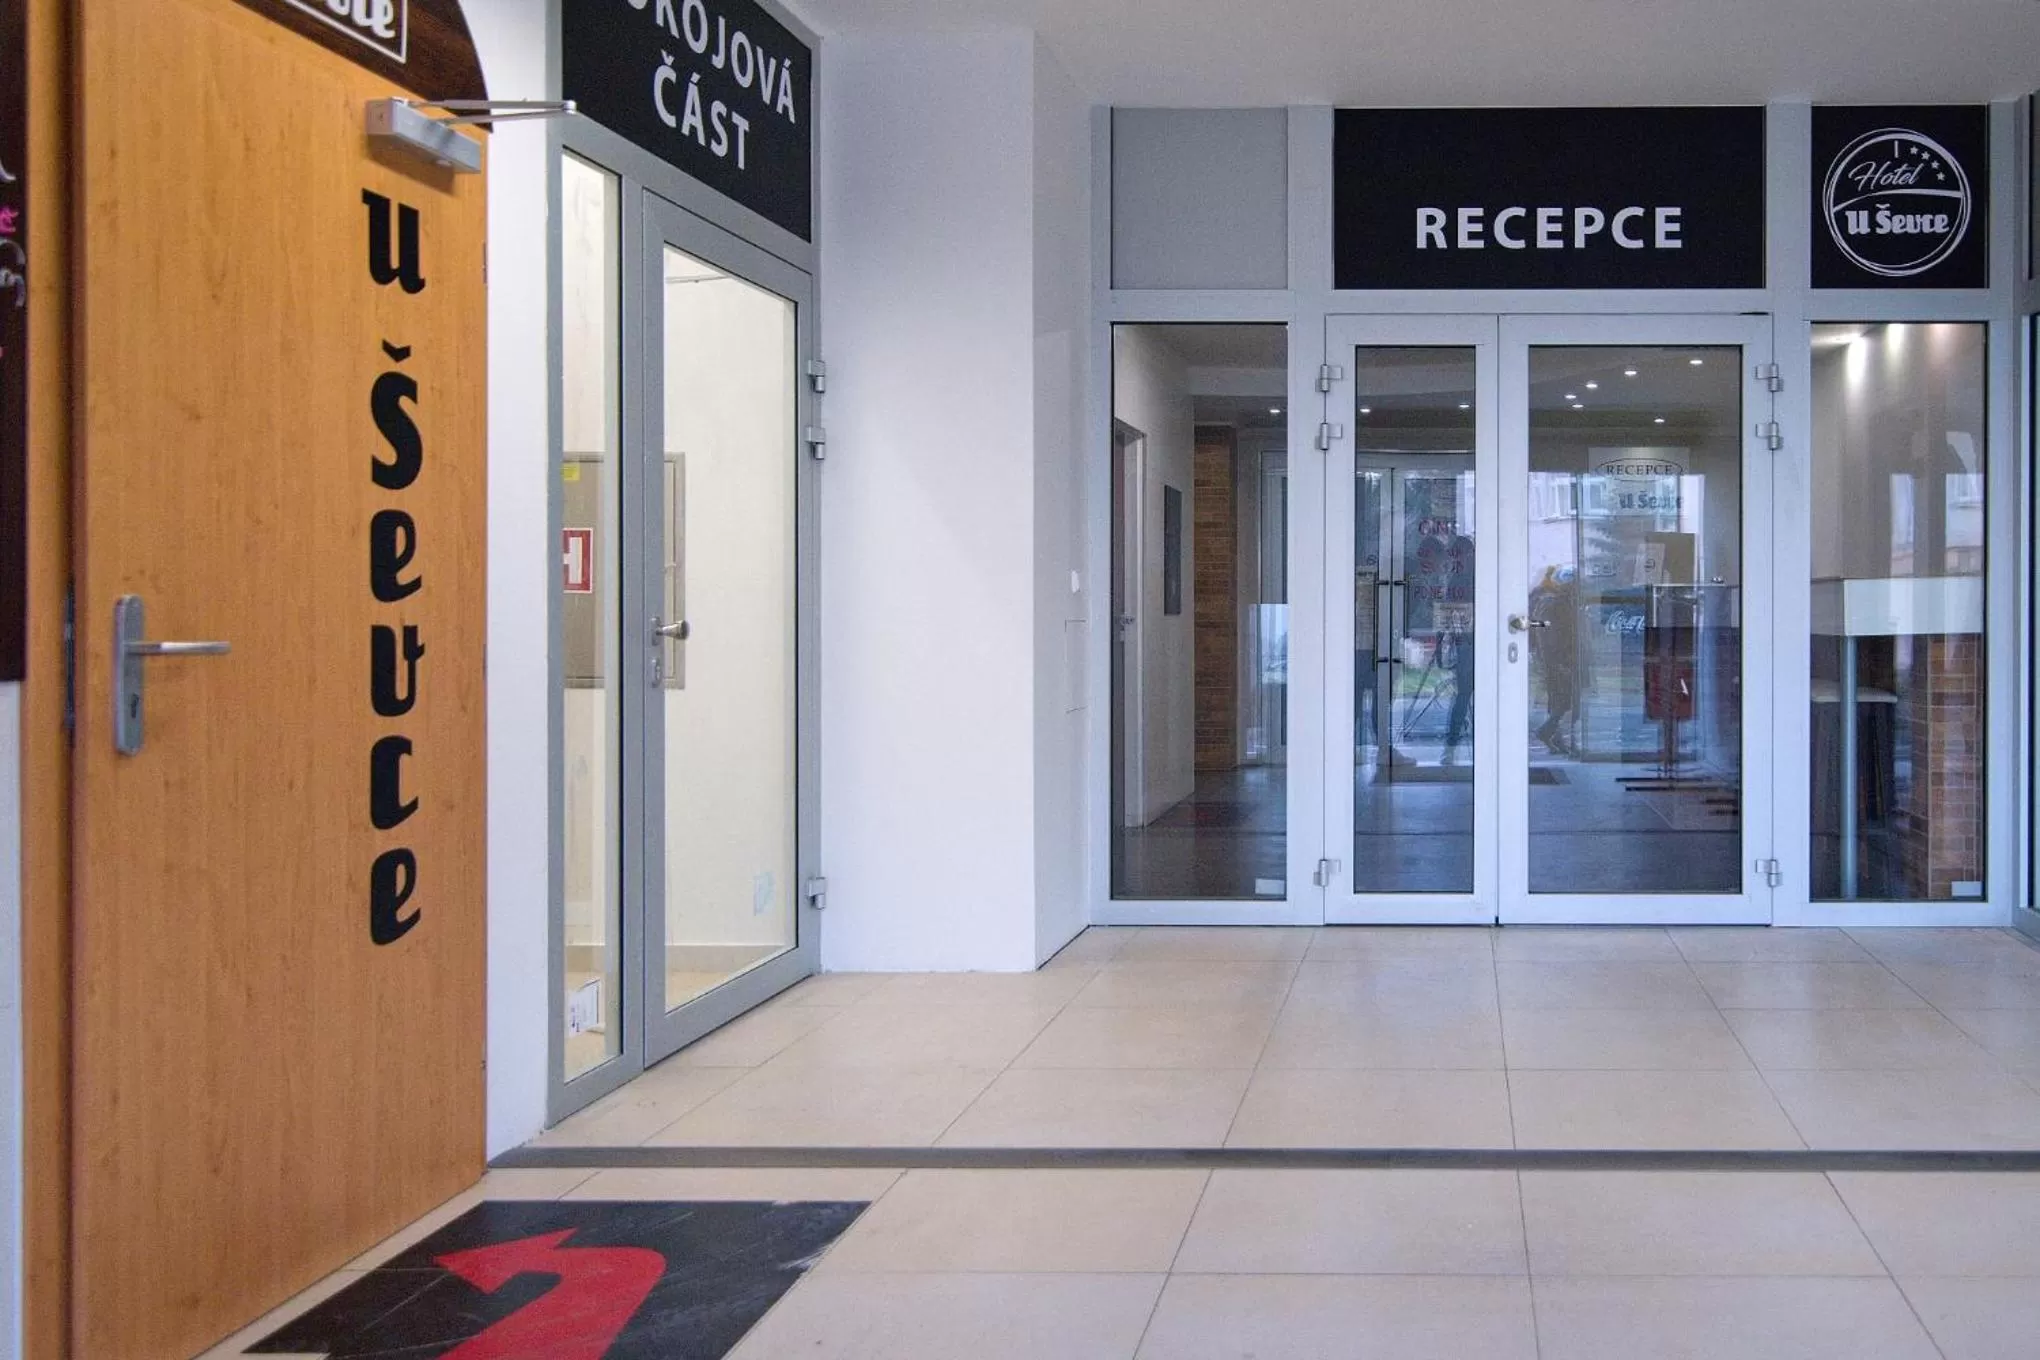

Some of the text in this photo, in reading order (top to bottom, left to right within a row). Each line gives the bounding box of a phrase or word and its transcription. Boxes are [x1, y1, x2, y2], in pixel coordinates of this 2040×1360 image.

[628, 0, 796, 124] KOJOVÁ
[654, 49, 750, 170] ČÁST
[1847, 160, 1925, 192] Hotel
[1415, 206, 1683, 249] RECEPCE
[1606, 464, 1674, 476] RECEPCE
